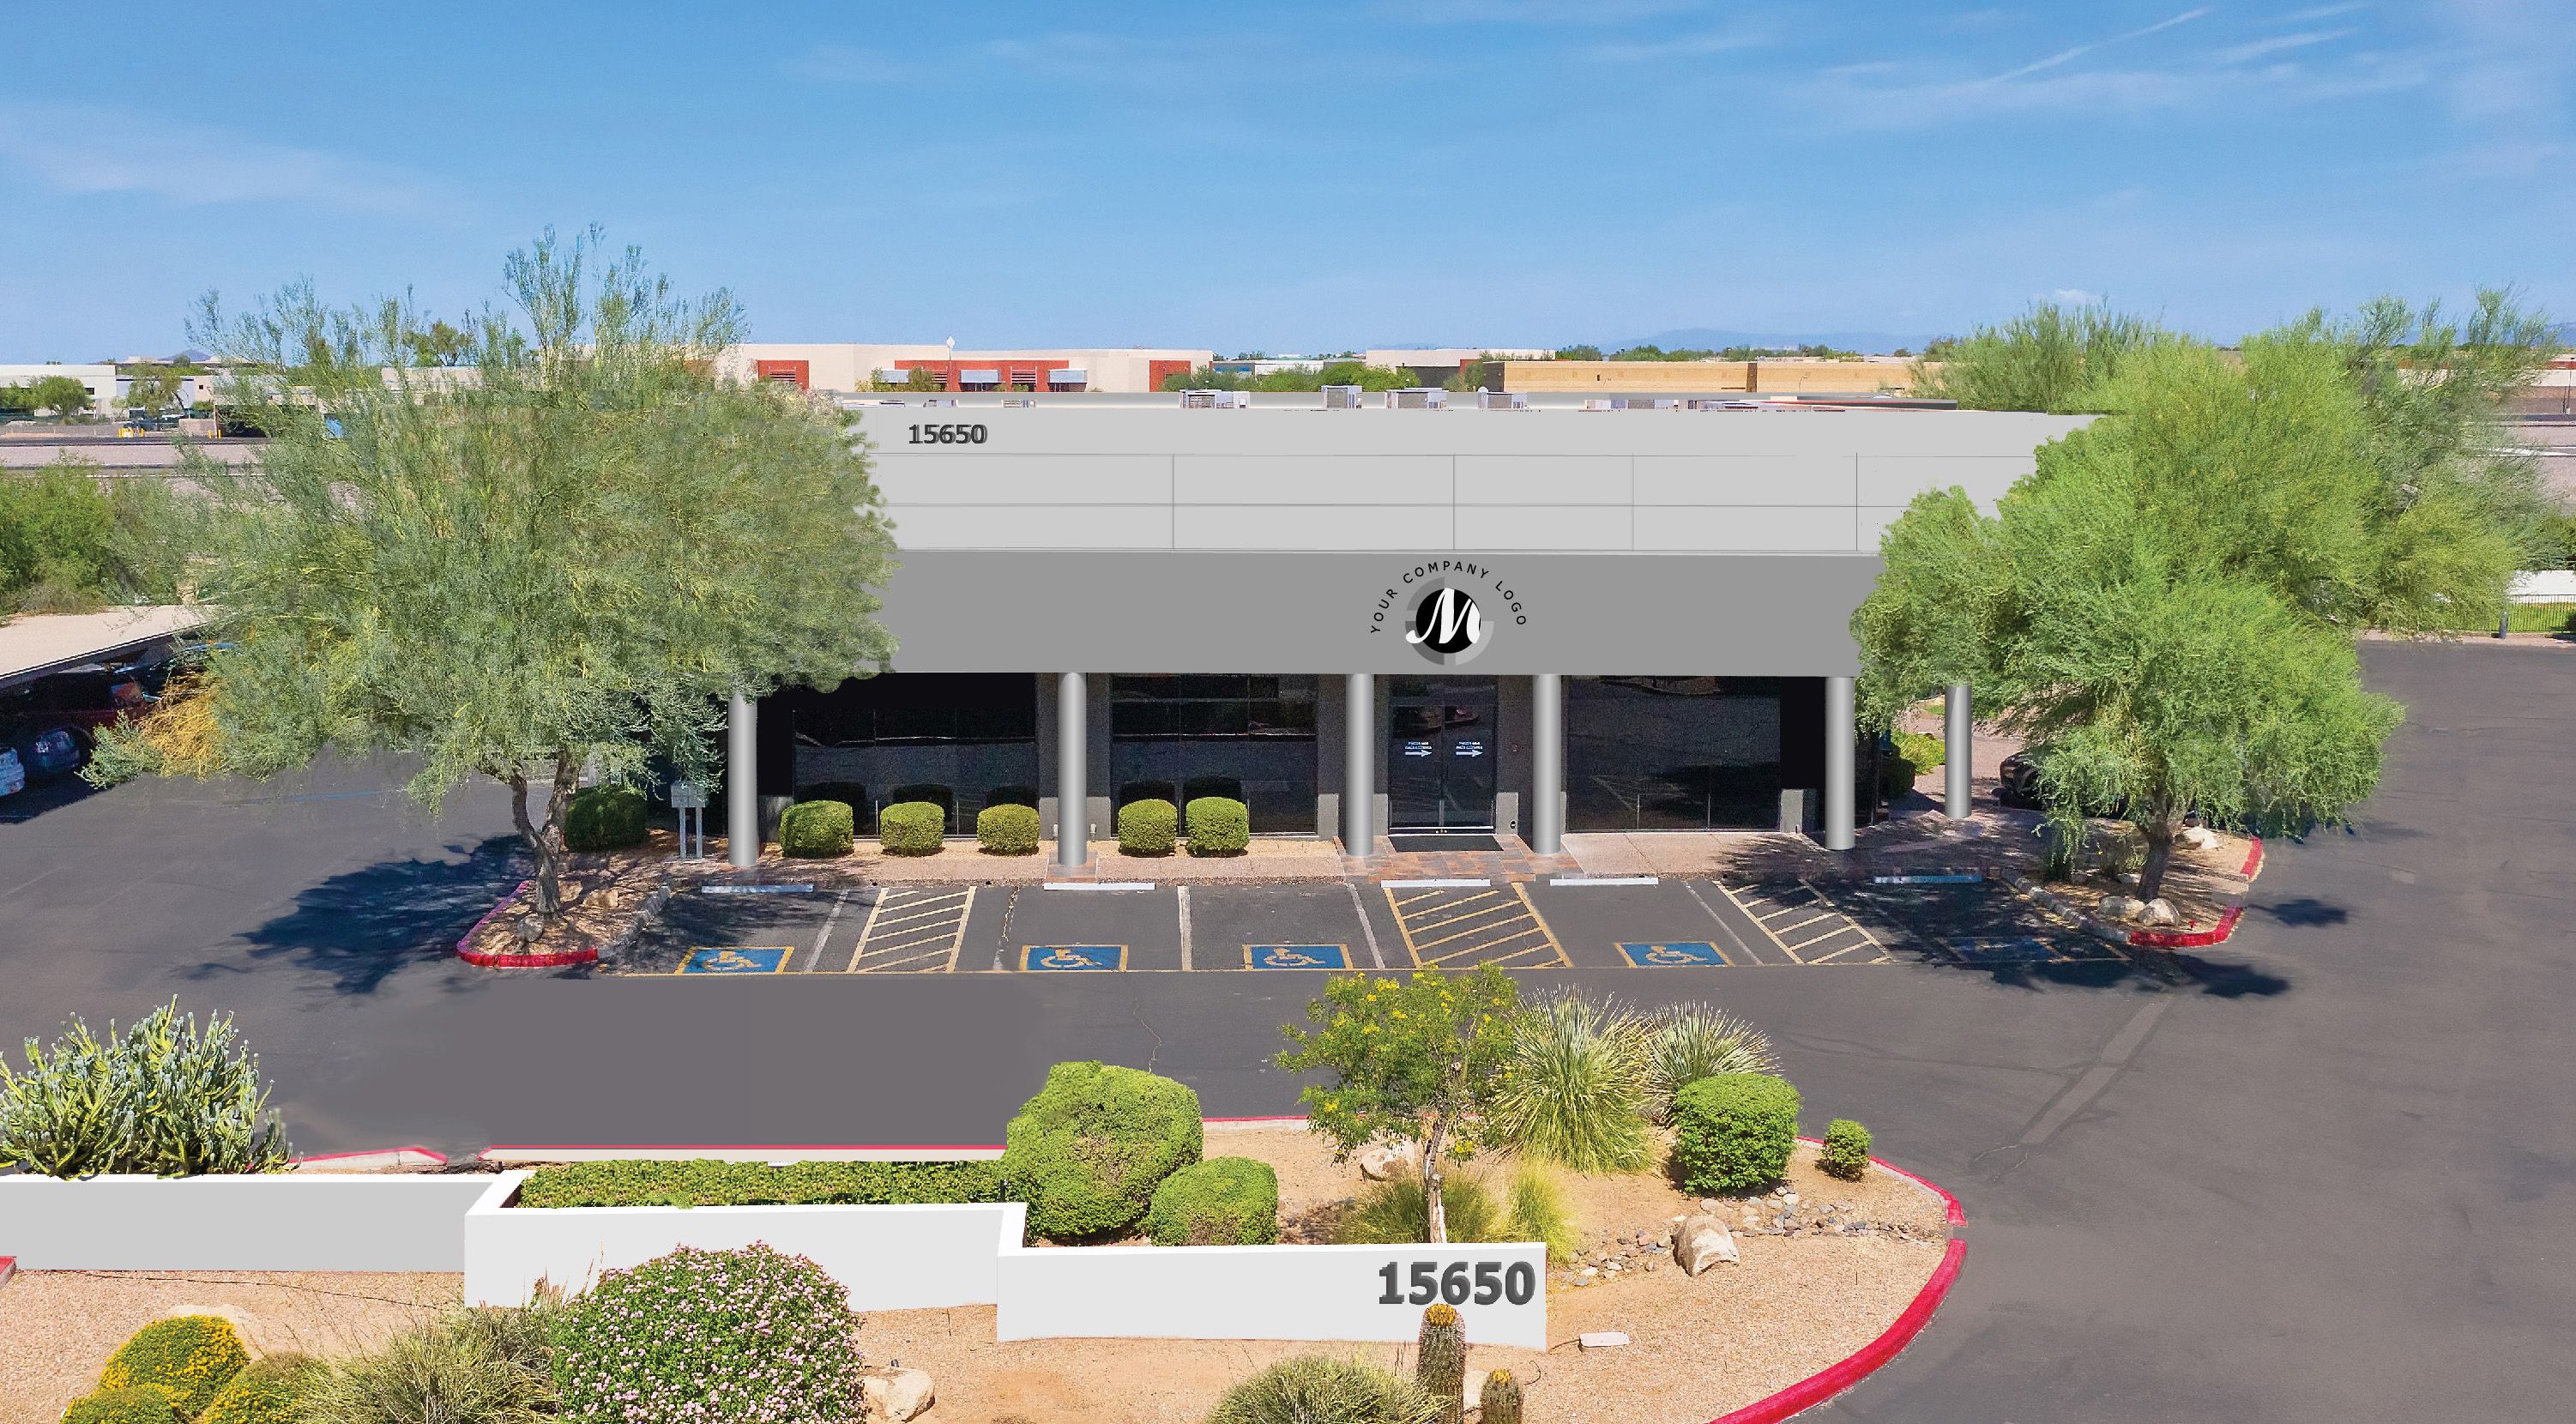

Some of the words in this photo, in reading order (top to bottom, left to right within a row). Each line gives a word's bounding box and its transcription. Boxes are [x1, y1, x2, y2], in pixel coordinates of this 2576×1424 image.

[908, 424, 988, 444] 15650
[1370, 588, 1398, 635] YOUR
[1403, 560, 1489, 584] COMPANY
[1495, 580, 1527, 625] LOGO
[1405, 588, 1481, 644] M
[1378, 1260, 1536, 1306] 15650
